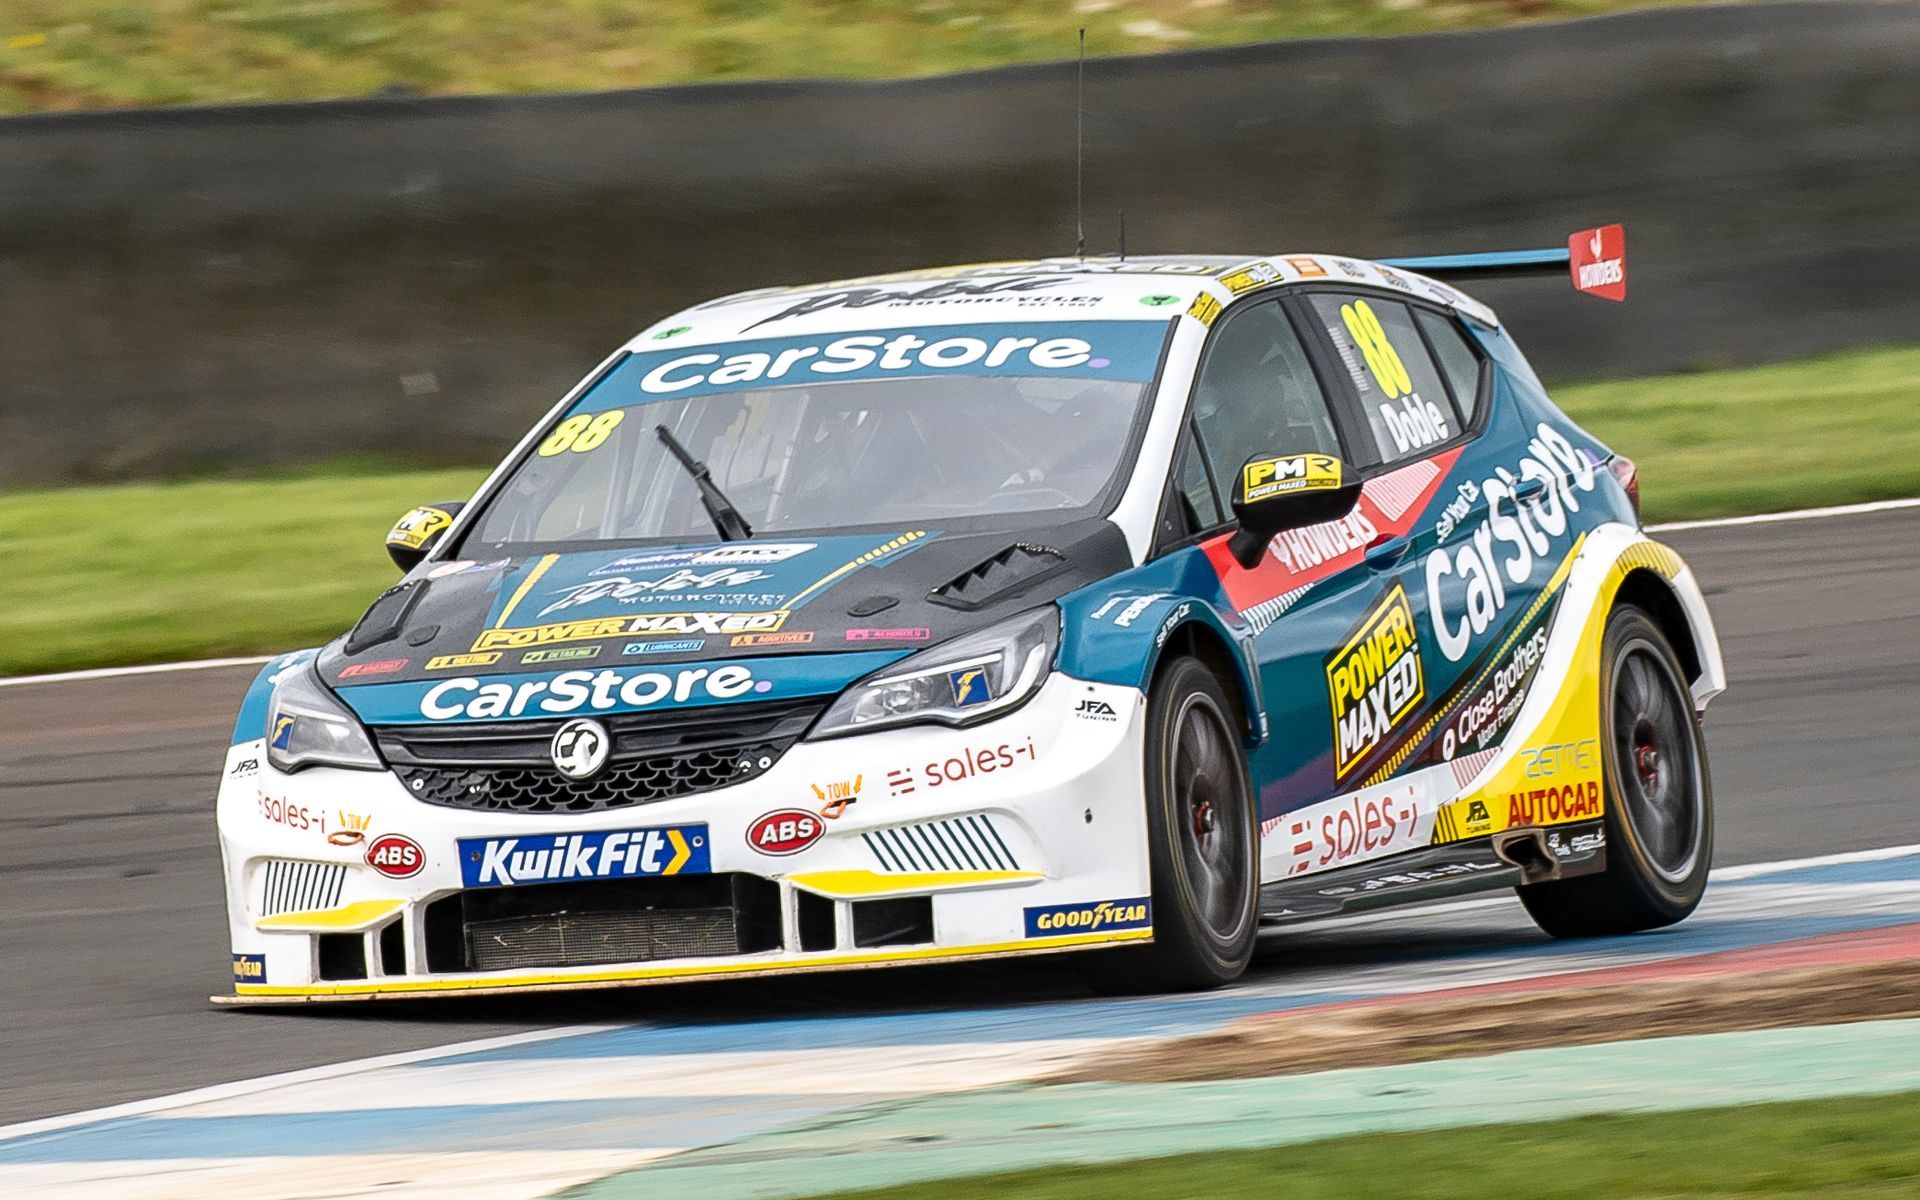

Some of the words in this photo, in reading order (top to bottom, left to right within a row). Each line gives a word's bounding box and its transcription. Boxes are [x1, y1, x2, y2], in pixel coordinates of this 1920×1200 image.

[1340, 299, 1413, 400] 88
[538, 409, 625, 457] 88
[1379, 392, 1449, 454] Doble
[481, 618, 627, 648] POWER
[624, 611, 778, 634] MAXED
[646, 640, 701, 652] LUBRICANTS
[756, 632, 804, 644] ADDITIVES
[1332, 604, 1413, 718] POWER
[1458, 690, 1495, 744] Close
[1494, 627, 1547, 705] Brothers
[1074, 699, 1117, 716] JFA
[1338, 650, 1418, 765] MAXED
[230, 758, 259, 774] JFA
[926, 735, 1038, 788] sales-i
[827, 780, 851, 799] TOW
[1507, 780, 1600, 828] AUTOCAR
[263, 795, 326, 834] sales-i
[758, 817, 816, 844] ABS
[1319, 784, 1419, 866] sales-i
[373, 846, 417, 867] ABS
[1037, 901, 1147, 932] GOODYEAR
